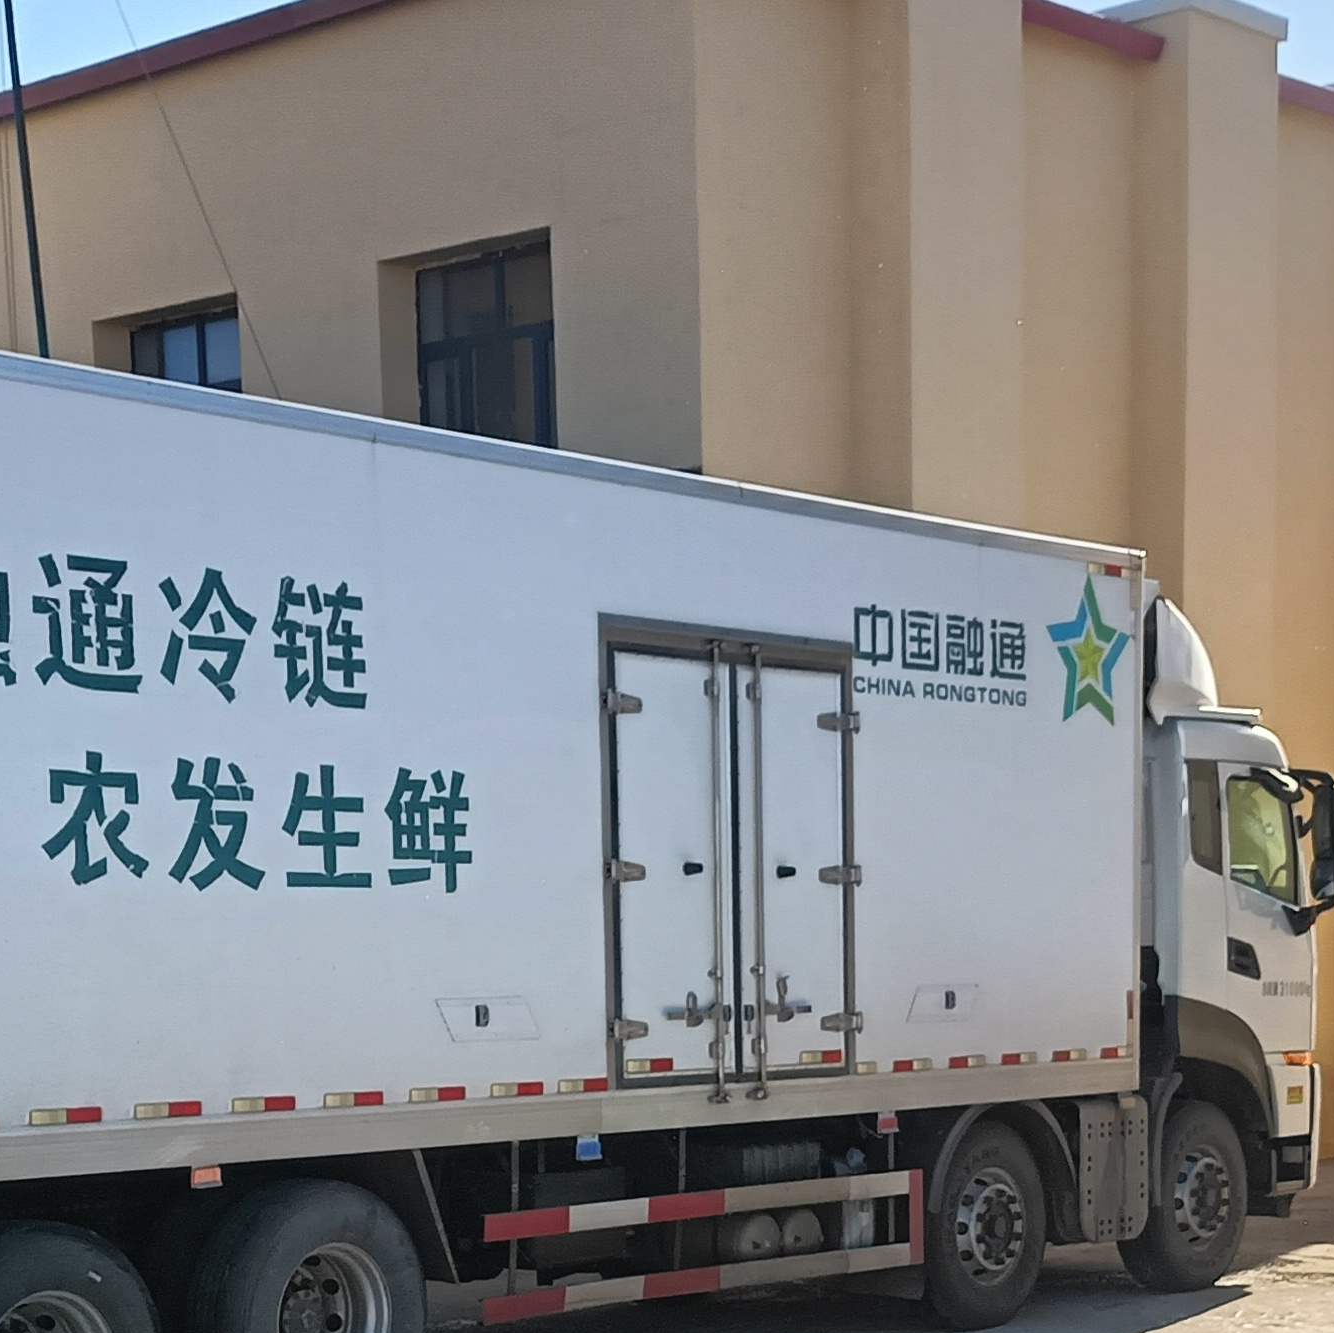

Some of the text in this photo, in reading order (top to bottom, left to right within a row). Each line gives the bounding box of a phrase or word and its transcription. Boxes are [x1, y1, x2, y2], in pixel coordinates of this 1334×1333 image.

[853, 603, 1026, 680] 中国融通
[853, 676, 1027, 707] CHINA RONGTONG
[42, 750, 473, 893] 农发生鲜
